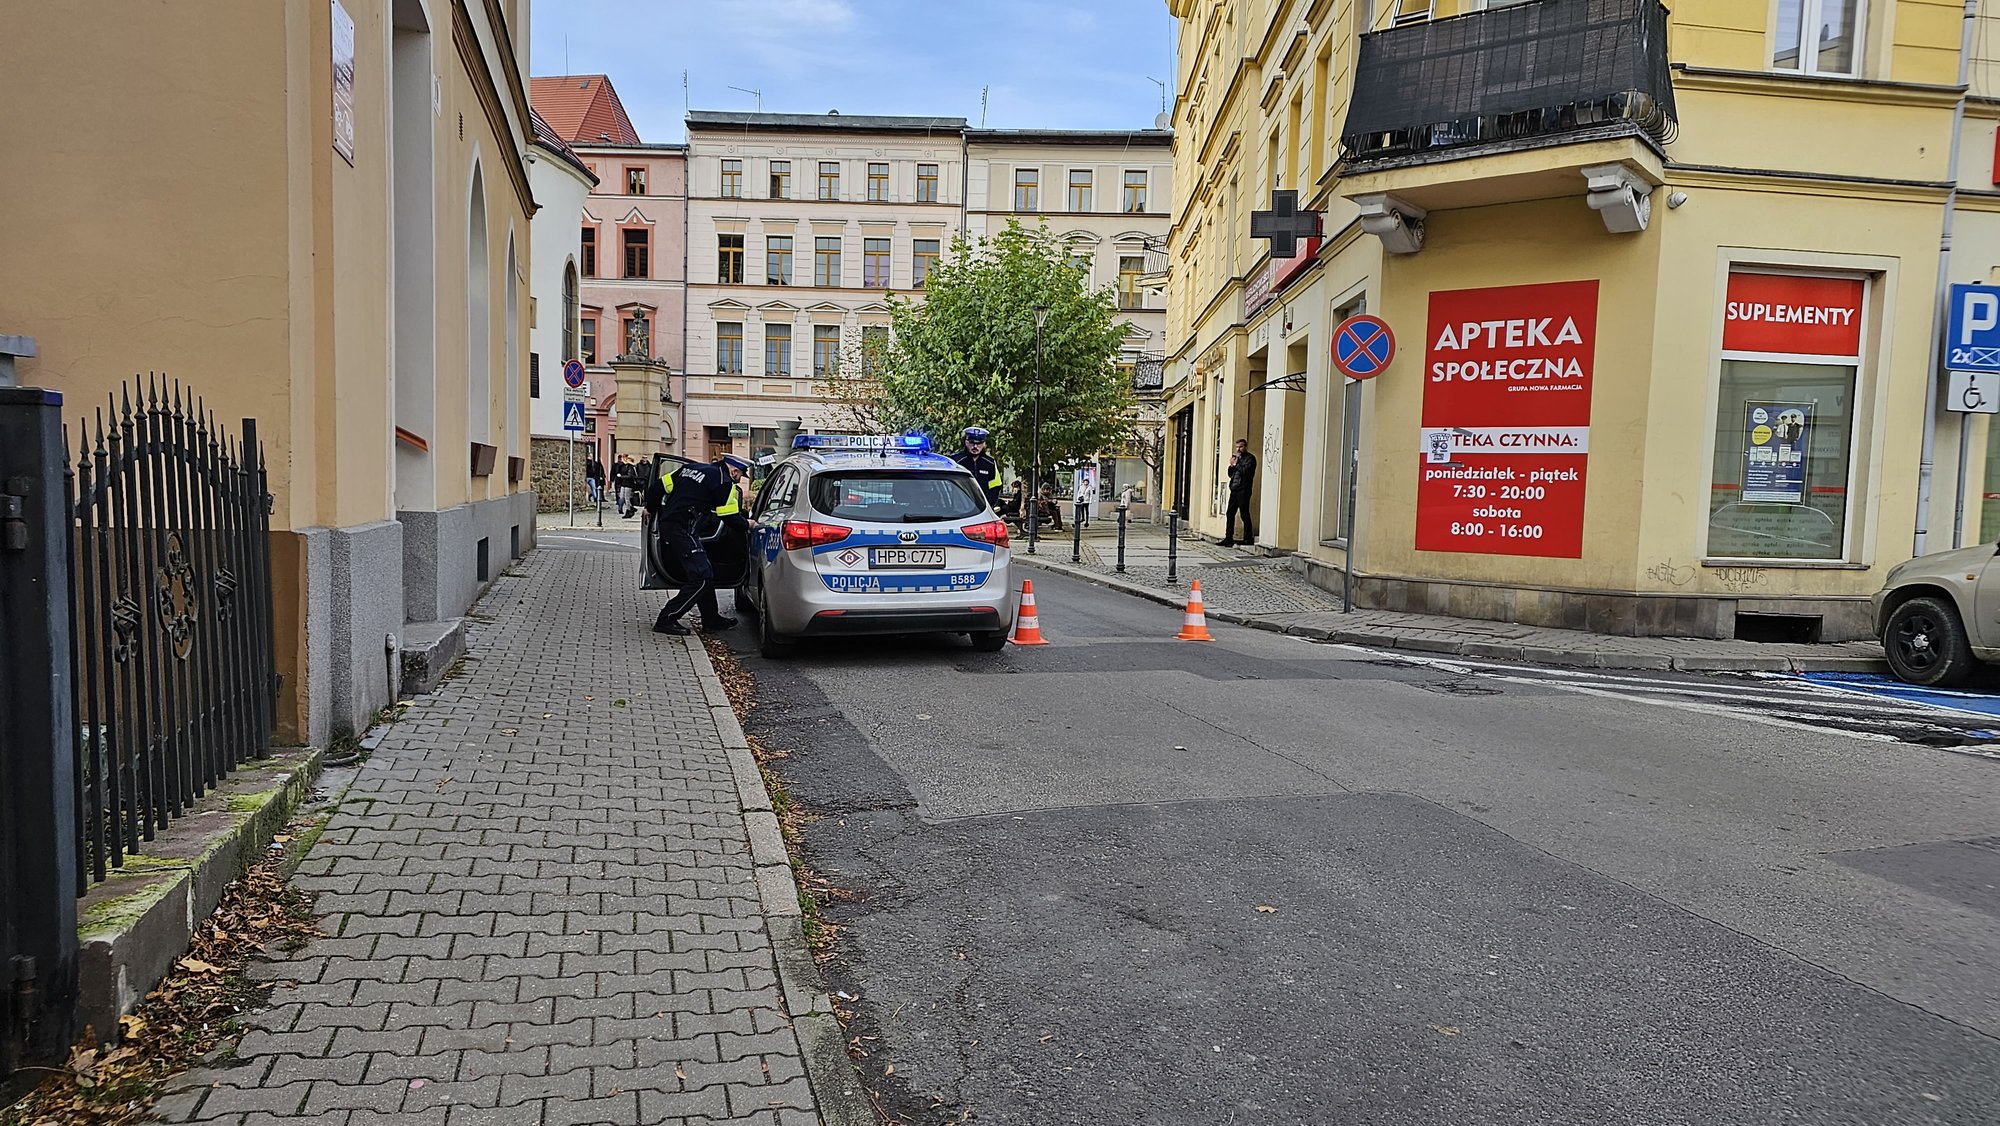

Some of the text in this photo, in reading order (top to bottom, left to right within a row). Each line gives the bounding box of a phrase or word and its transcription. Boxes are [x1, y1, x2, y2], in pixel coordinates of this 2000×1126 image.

[1727, 301, 1855, 326] SUPLEMENTY
[1961, 292, 1998, 345] P
[1433, 315, 1583, 351] APTEKA
[1432, 356, 1584, 382] SPOŁECZNA
[849, 436, 893, 447] POLICJA
[1499, 433, 1579, 447] CZYNNA:
[678, 467, 706, 484] POLICJA
[1425, 466, 1515, 481] poniedziałek
[1530, 467, 1579, 484] piątek
[1453, 485, 1486, 498] 7:30
[1500, 486, 1545, 500] 20:00
[1472, 504, 1522, 519] sobota
[901, 532, 916, 540] KIA
[1450, 522, 1484, 536] 8:00
[1500, 524, 1543, 539] 16:00
[877, 550, 943, 564] HPB C775
[832, 576, 880, 588] POLICJA
[950, 574, 976, 585] B588
